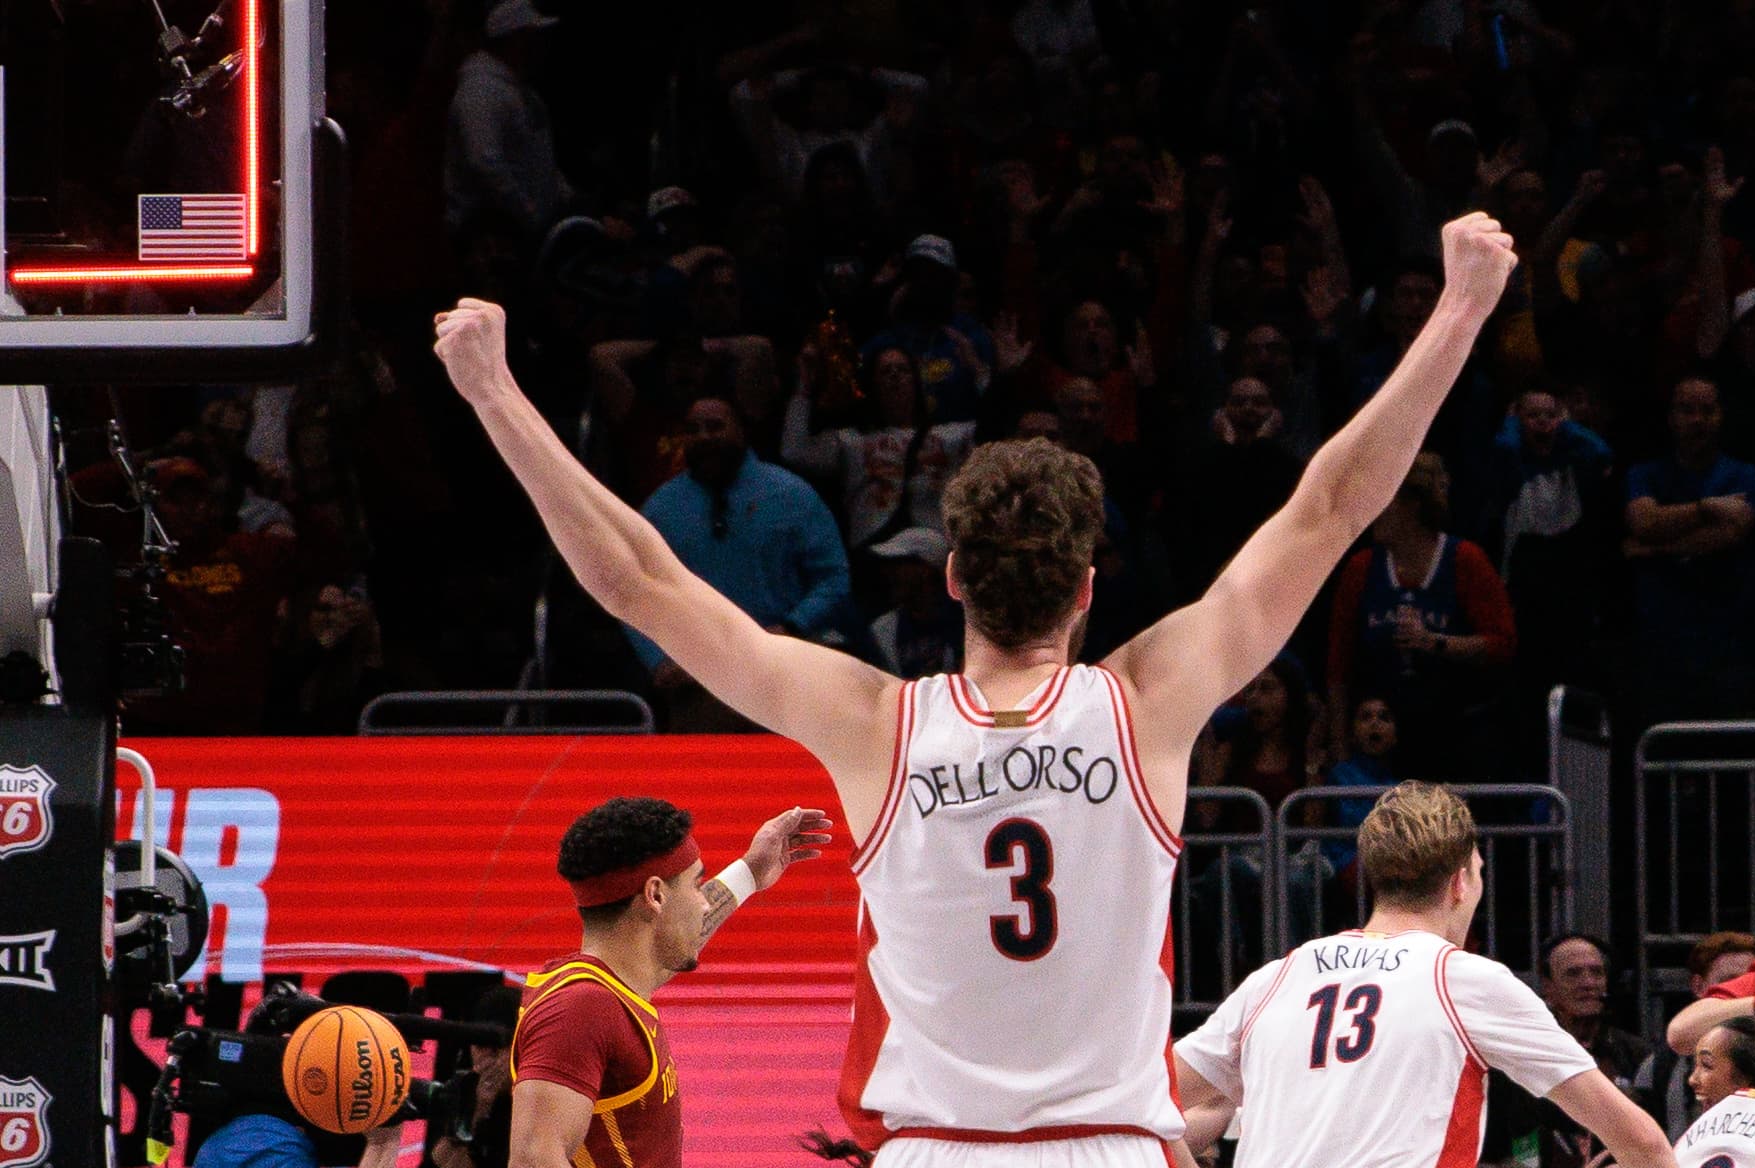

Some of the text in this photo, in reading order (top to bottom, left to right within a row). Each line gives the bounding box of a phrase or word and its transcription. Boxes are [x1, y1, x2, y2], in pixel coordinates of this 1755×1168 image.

[984, 817, 1059, 962] 3
[1314, 945, 1409, 974] KRIVAS
[1306, 983, 1383, 1069] 13
[348, 1041, 373, 1122] Wilson
[389, 1047, 405, 1105] NCAA
